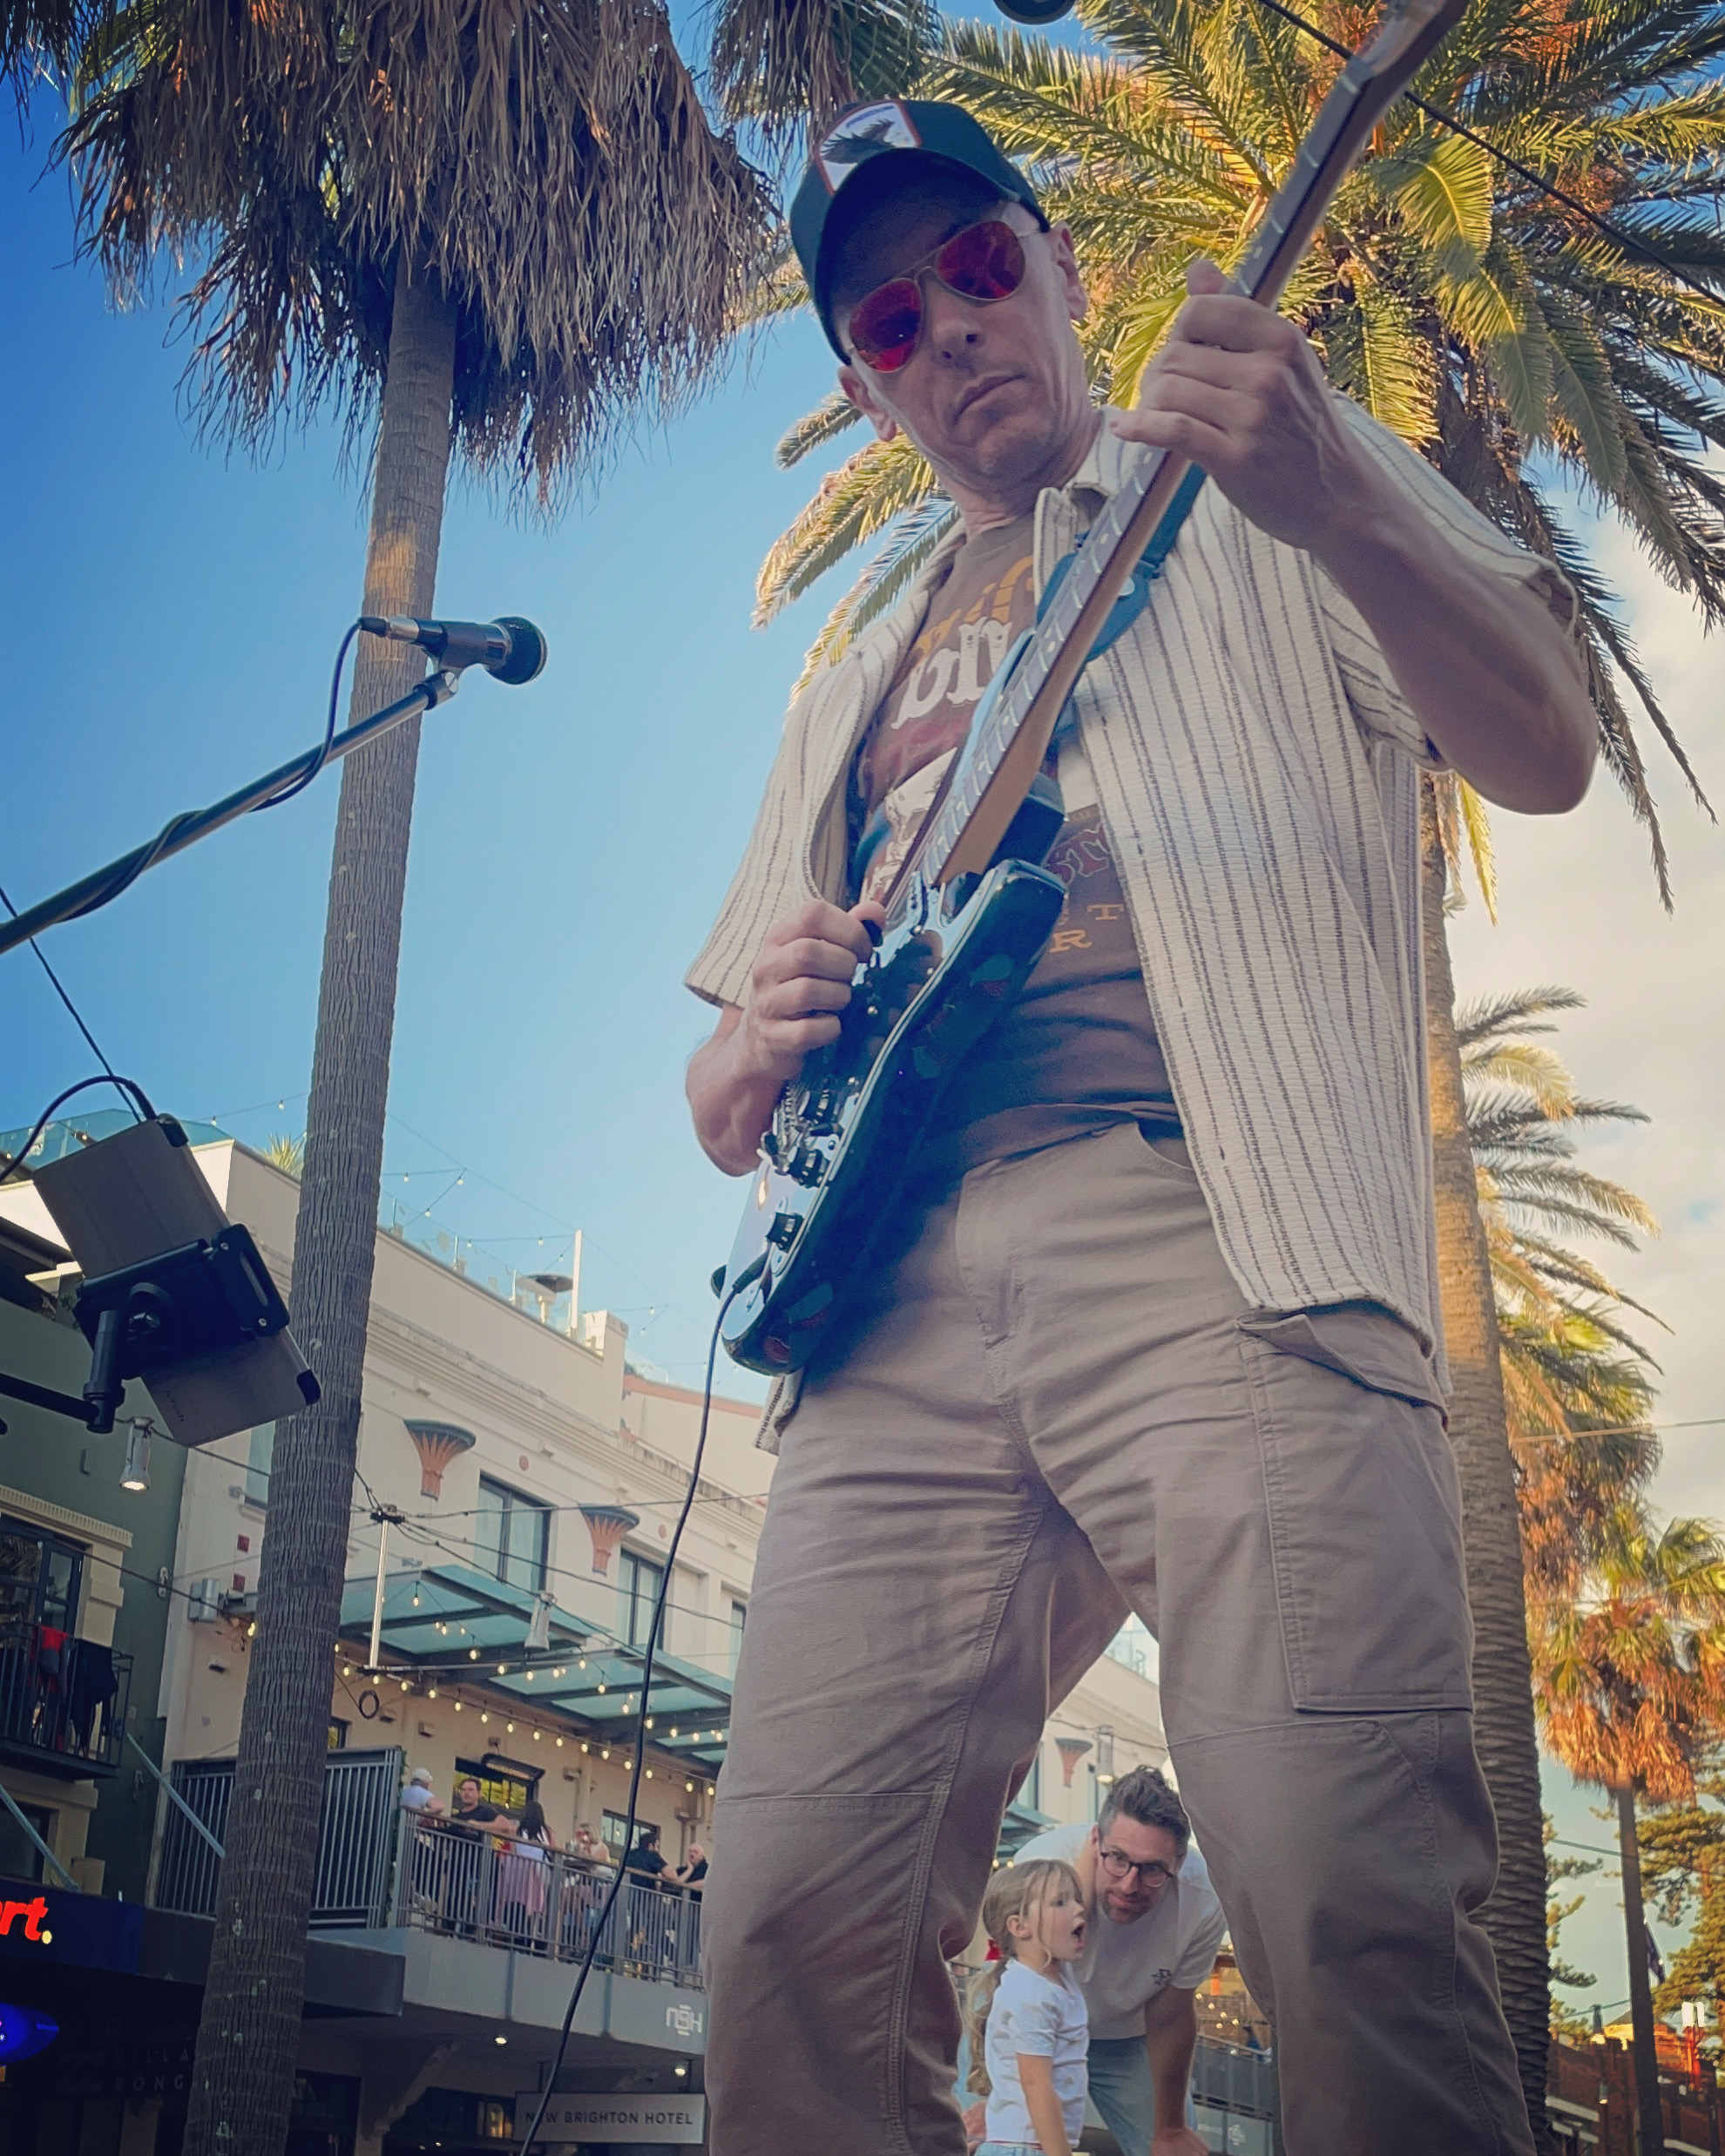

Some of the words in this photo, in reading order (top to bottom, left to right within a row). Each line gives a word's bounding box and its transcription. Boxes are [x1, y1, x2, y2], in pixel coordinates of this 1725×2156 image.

[0, 1897, 52, 1944] rt.
[525, 2112, 558, 2124] NW
[564, 2112, 639, 2125] BRIGHTON
[644, 2112, 693, 2126] HOTEL
